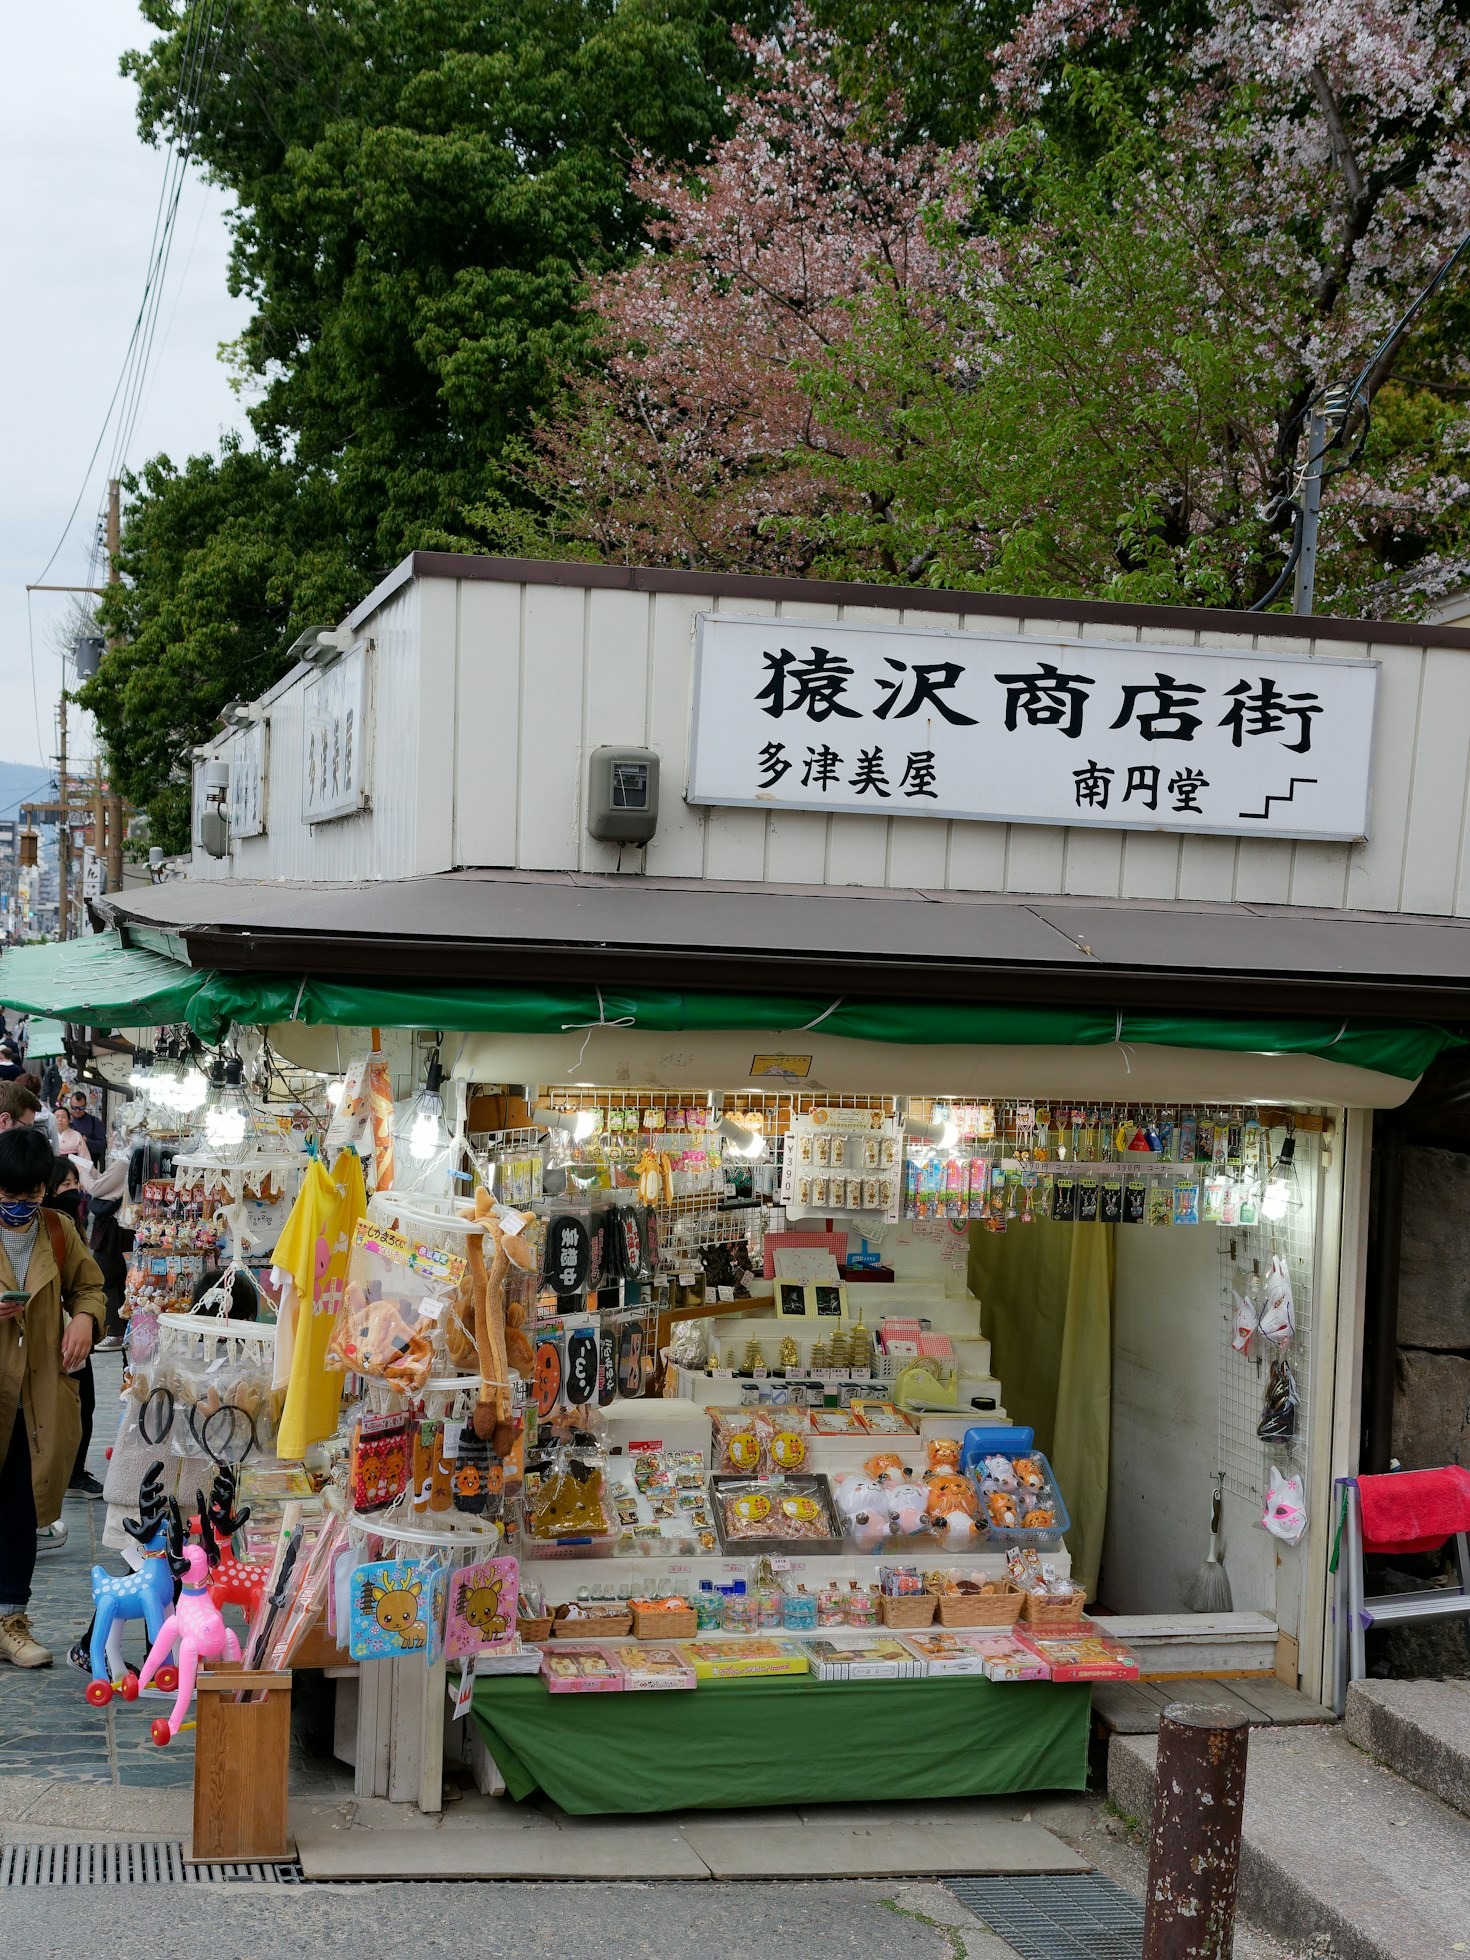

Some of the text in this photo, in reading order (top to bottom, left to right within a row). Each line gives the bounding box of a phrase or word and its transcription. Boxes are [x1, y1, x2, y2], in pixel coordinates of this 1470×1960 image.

[755, 646, 1323, 753] 猿沢商店街
[756, 741, 939, 799] 多津美屋
[1072, 759, 1211, 814] 南円堂
[1024, 1162, 1048, 1170] 390円
[367, 1225, 405, 1249] しかまろくん
[559, 1228, 579, 1286] 妄想中
